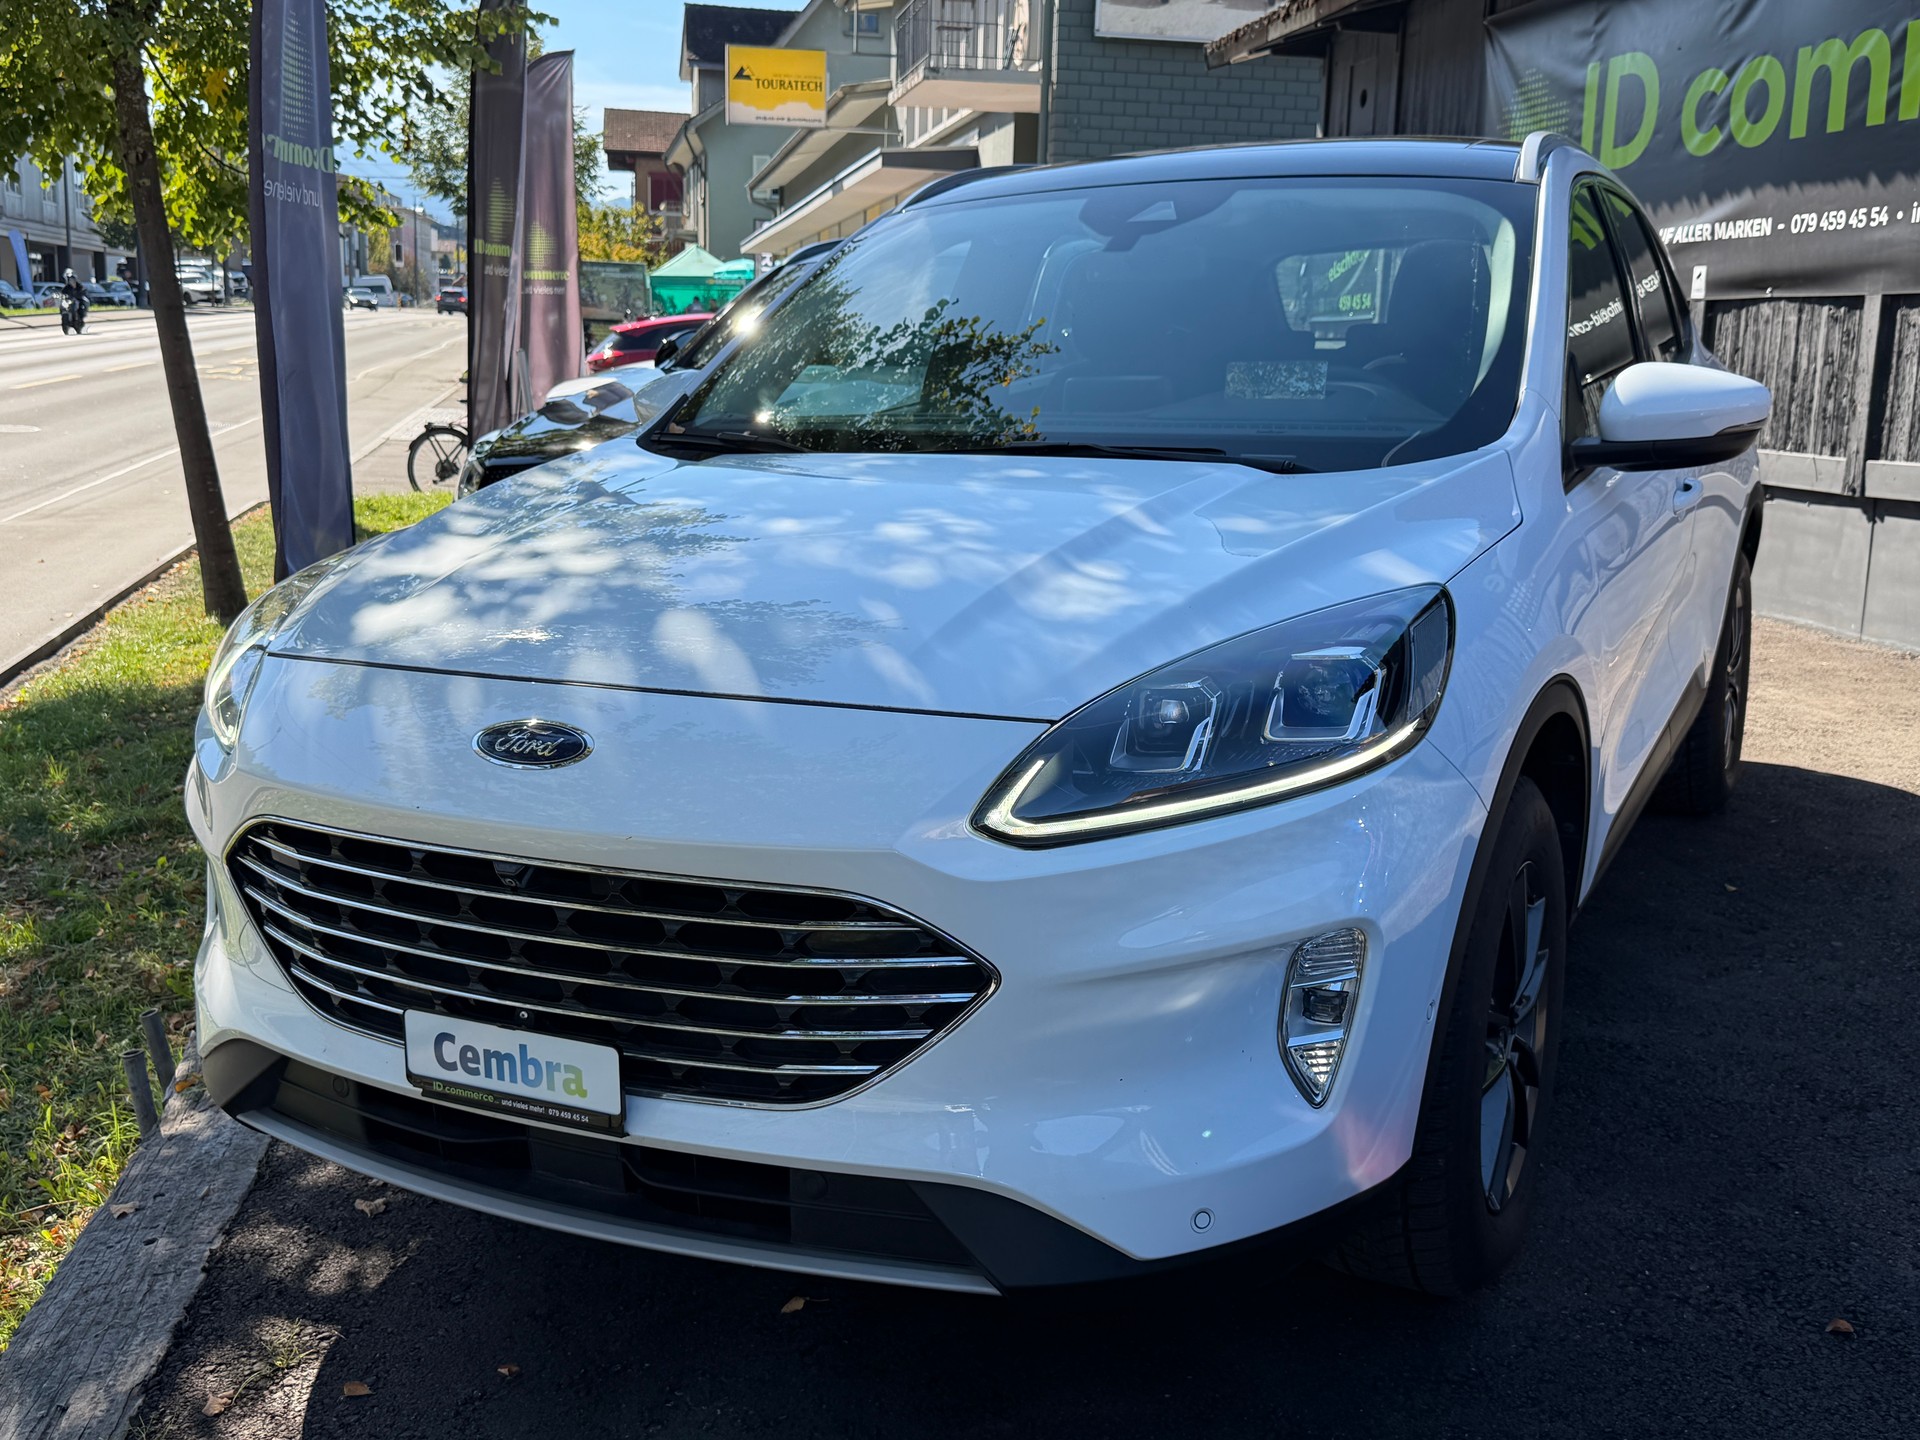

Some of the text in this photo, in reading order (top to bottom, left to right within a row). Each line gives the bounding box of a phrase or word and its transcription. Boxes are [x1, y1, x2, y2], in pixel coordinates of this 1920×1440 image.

[755, 78, 823, 92] TOURATECH
[1581, 51, 1660, 170] ID
[1673, 222, 1712, 244] ALLER
[1714, 216, 1773, 241] MARKEN
[1790, 212, 1818, 234] 079
[1819, 209, 1847, 232] 459
[1848, 207, 1868, 229] 45
[1870, 205, 1889, 228] 54
[494, 726, 565, 757] Ford
[433, 1031, 588, 1099] Cembra
[432, 1081, 444, 1092] ID
[501, 1098, 512, 1107] und
[512, 1100, 528, 1111] vieles
[548, 1107, 560, 1117] 079
[560, 1110, 572, 1119] 459
[572, 1113, 581, 1122] 45
[580, 1114, 590, 1123] 54
